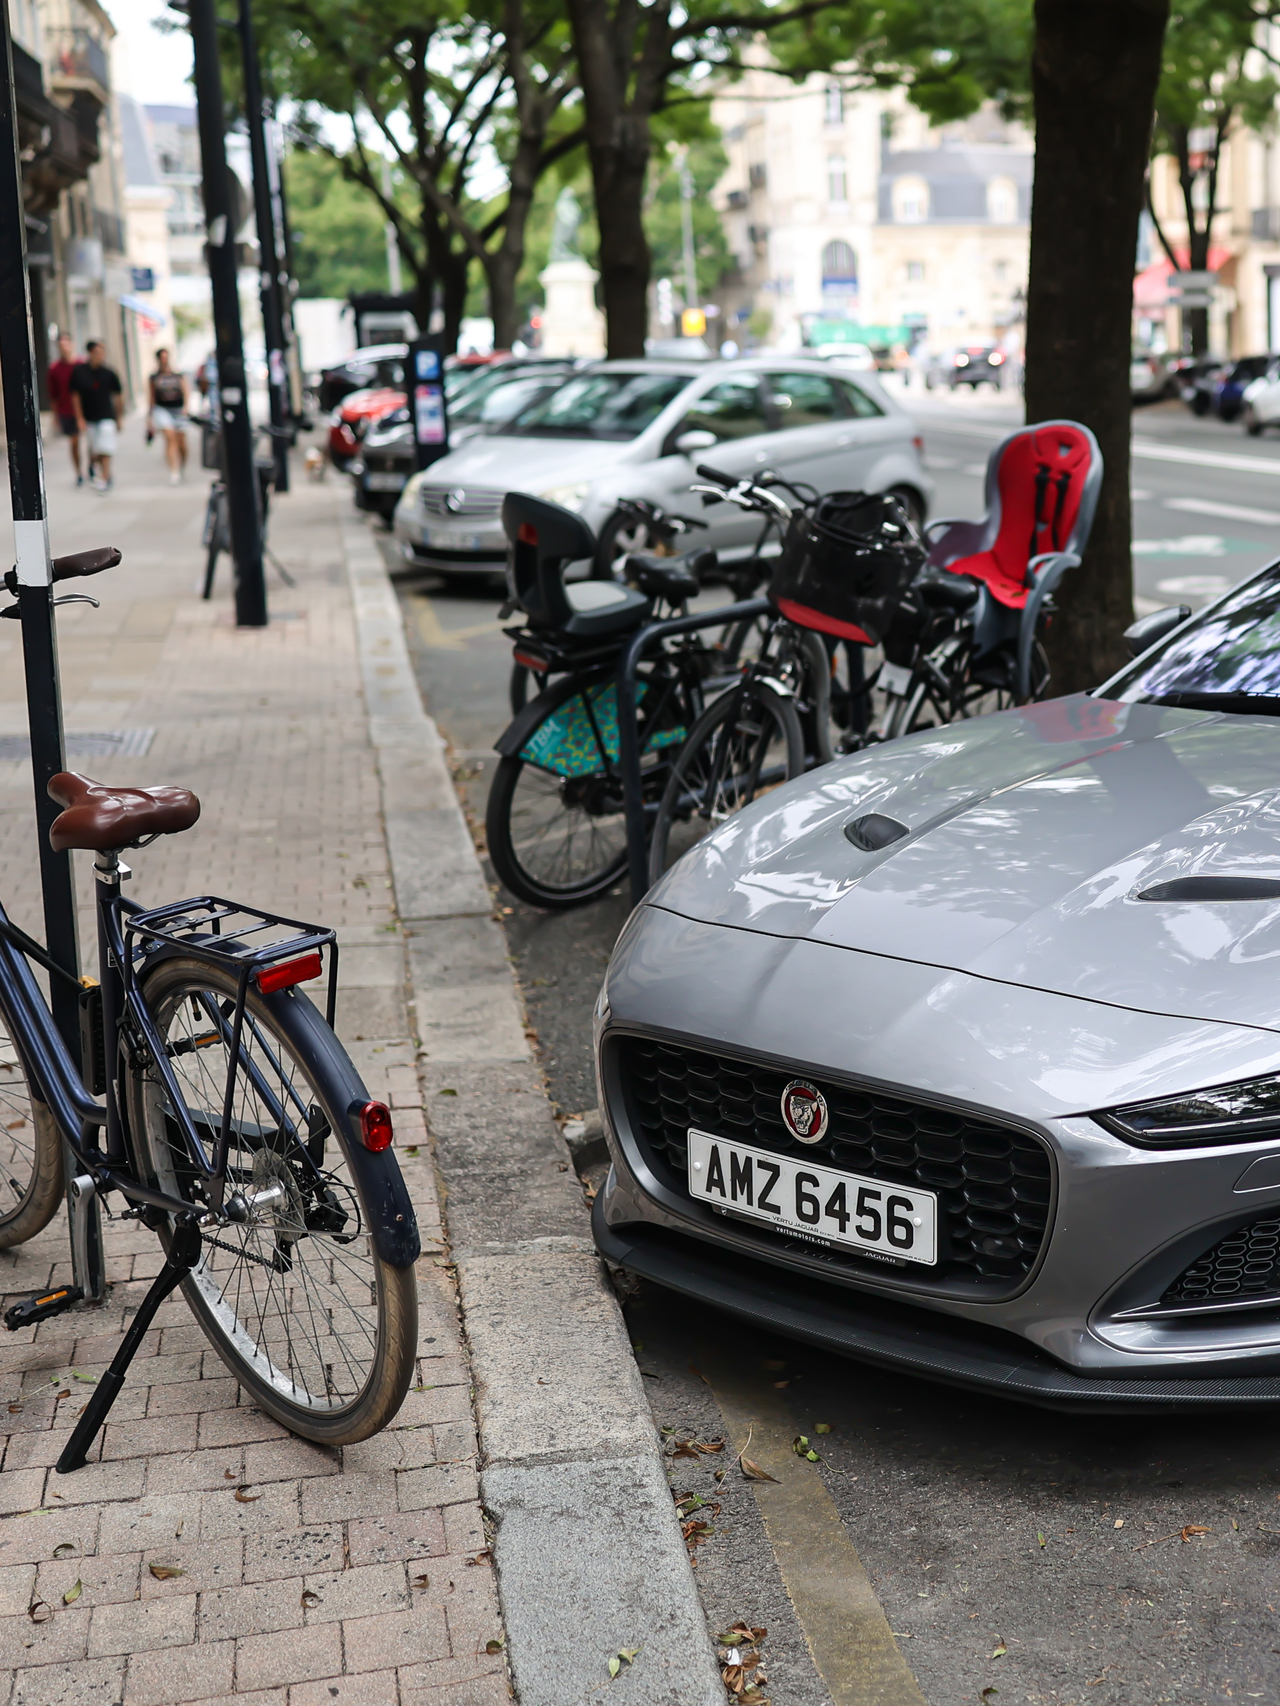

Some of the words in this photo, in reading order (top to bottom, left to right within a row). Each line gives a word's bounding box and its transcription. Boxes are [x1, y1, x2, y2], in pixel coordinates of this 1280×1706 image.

[417, 351, 438, 377] P
[705, 1144, 781, 1215] AMZ
[795, 1172, 914, 1250] 6456
[772, 1216, 793, 1226] VERTU
[794, 1223, 819, 1233] JAGUAR
[776, 1226, 831, 1247] vertumotors.com
[863, 1252, 896, 1264] JAGUAR
